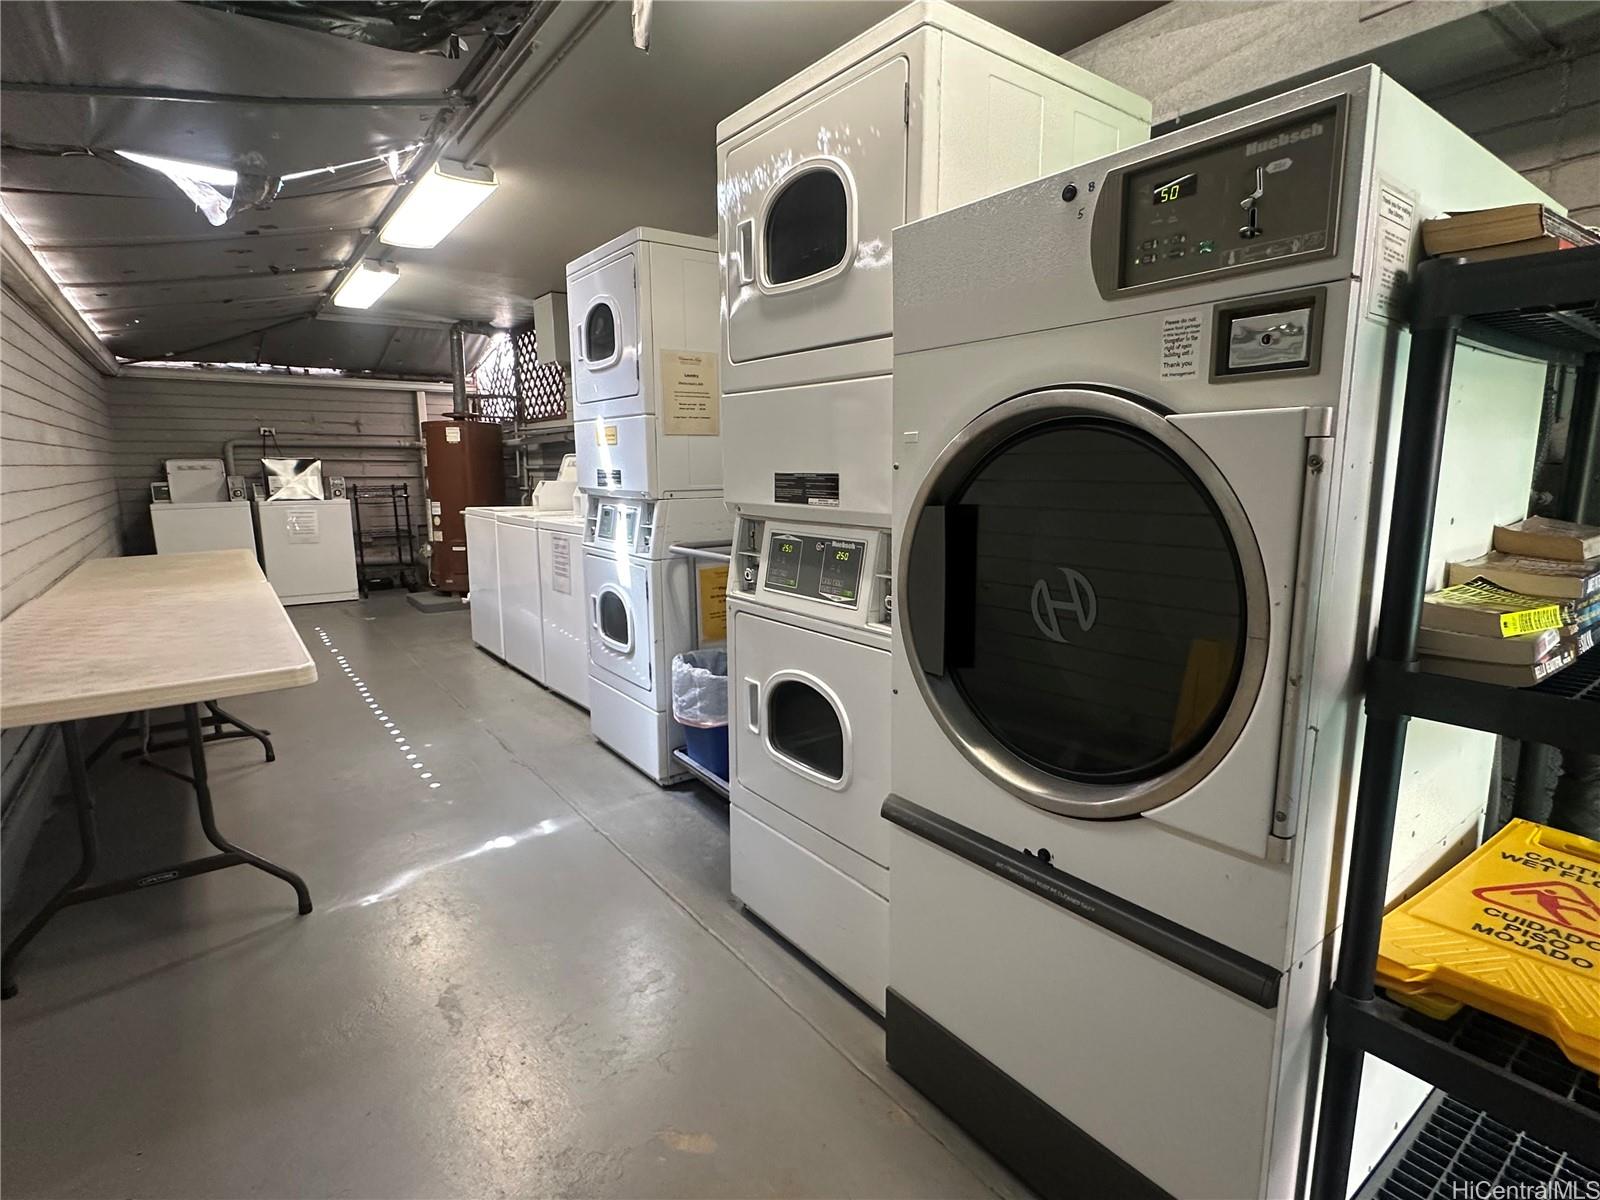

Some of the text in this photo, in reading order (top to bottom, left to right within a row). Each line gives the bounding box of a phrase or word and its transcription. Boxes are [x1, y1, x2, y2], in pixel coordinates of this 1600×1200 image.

[1245, 123, 1324, 157] Huebsch
[1160, 185, 1180, 203] 50
[1163, 361, 1193, 369] Thank you
[836, 551, 849, 561] 250
[1502, 851, 1556, 872] WET
[1525, 852, 1600, 879] CAUTI
[1483, 907, 1600, 952] CUIDADO
[1503, 923, 1570, 950] PISO
[1471, 922, 1594, 969] MOJADO
